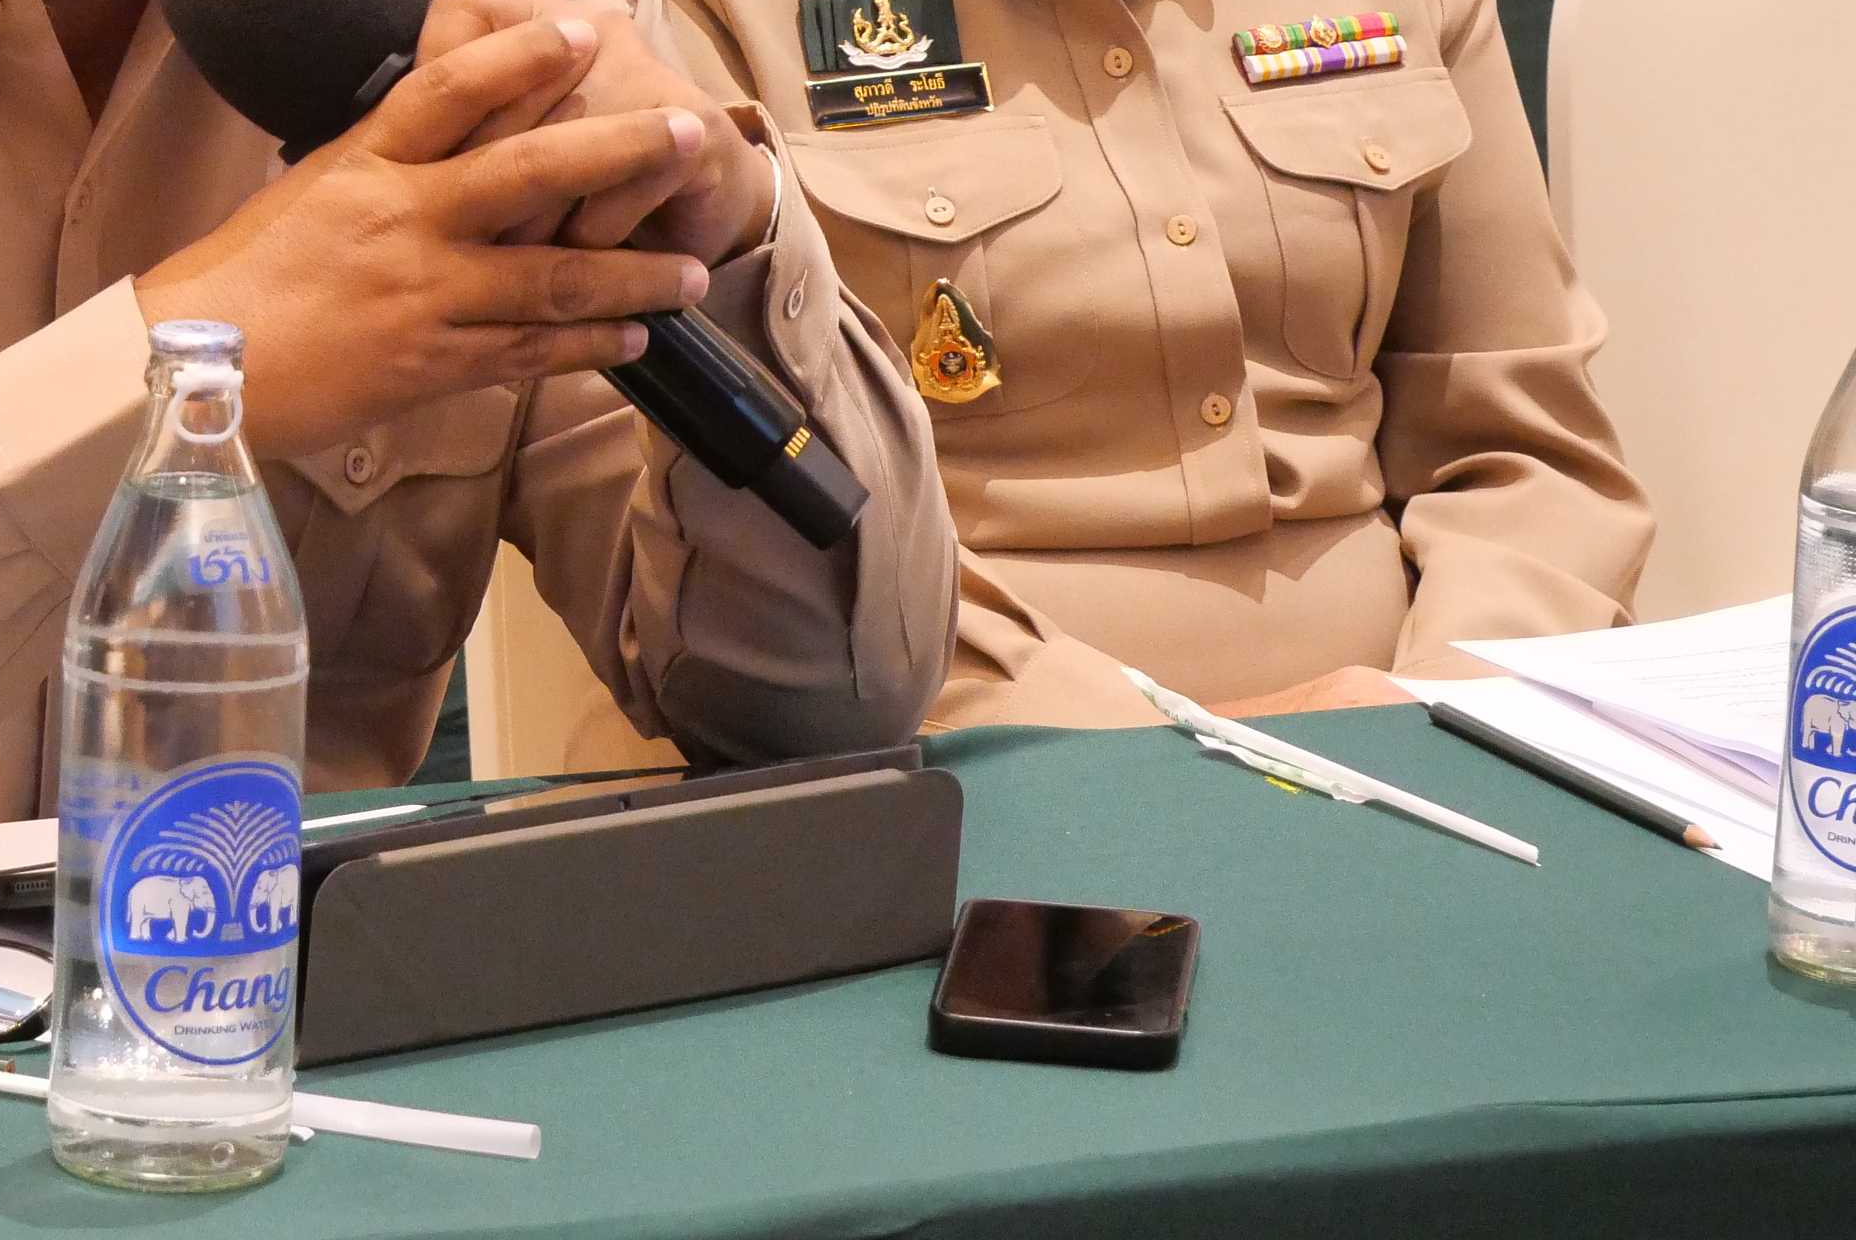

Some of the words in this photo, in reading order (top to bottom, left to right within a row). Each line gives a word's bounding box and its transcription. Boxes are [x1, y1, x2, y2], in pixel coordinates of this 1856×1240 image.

[854, 77, 895, 103] สุภาวดี
[144, 964, 292, 1014] Chang
